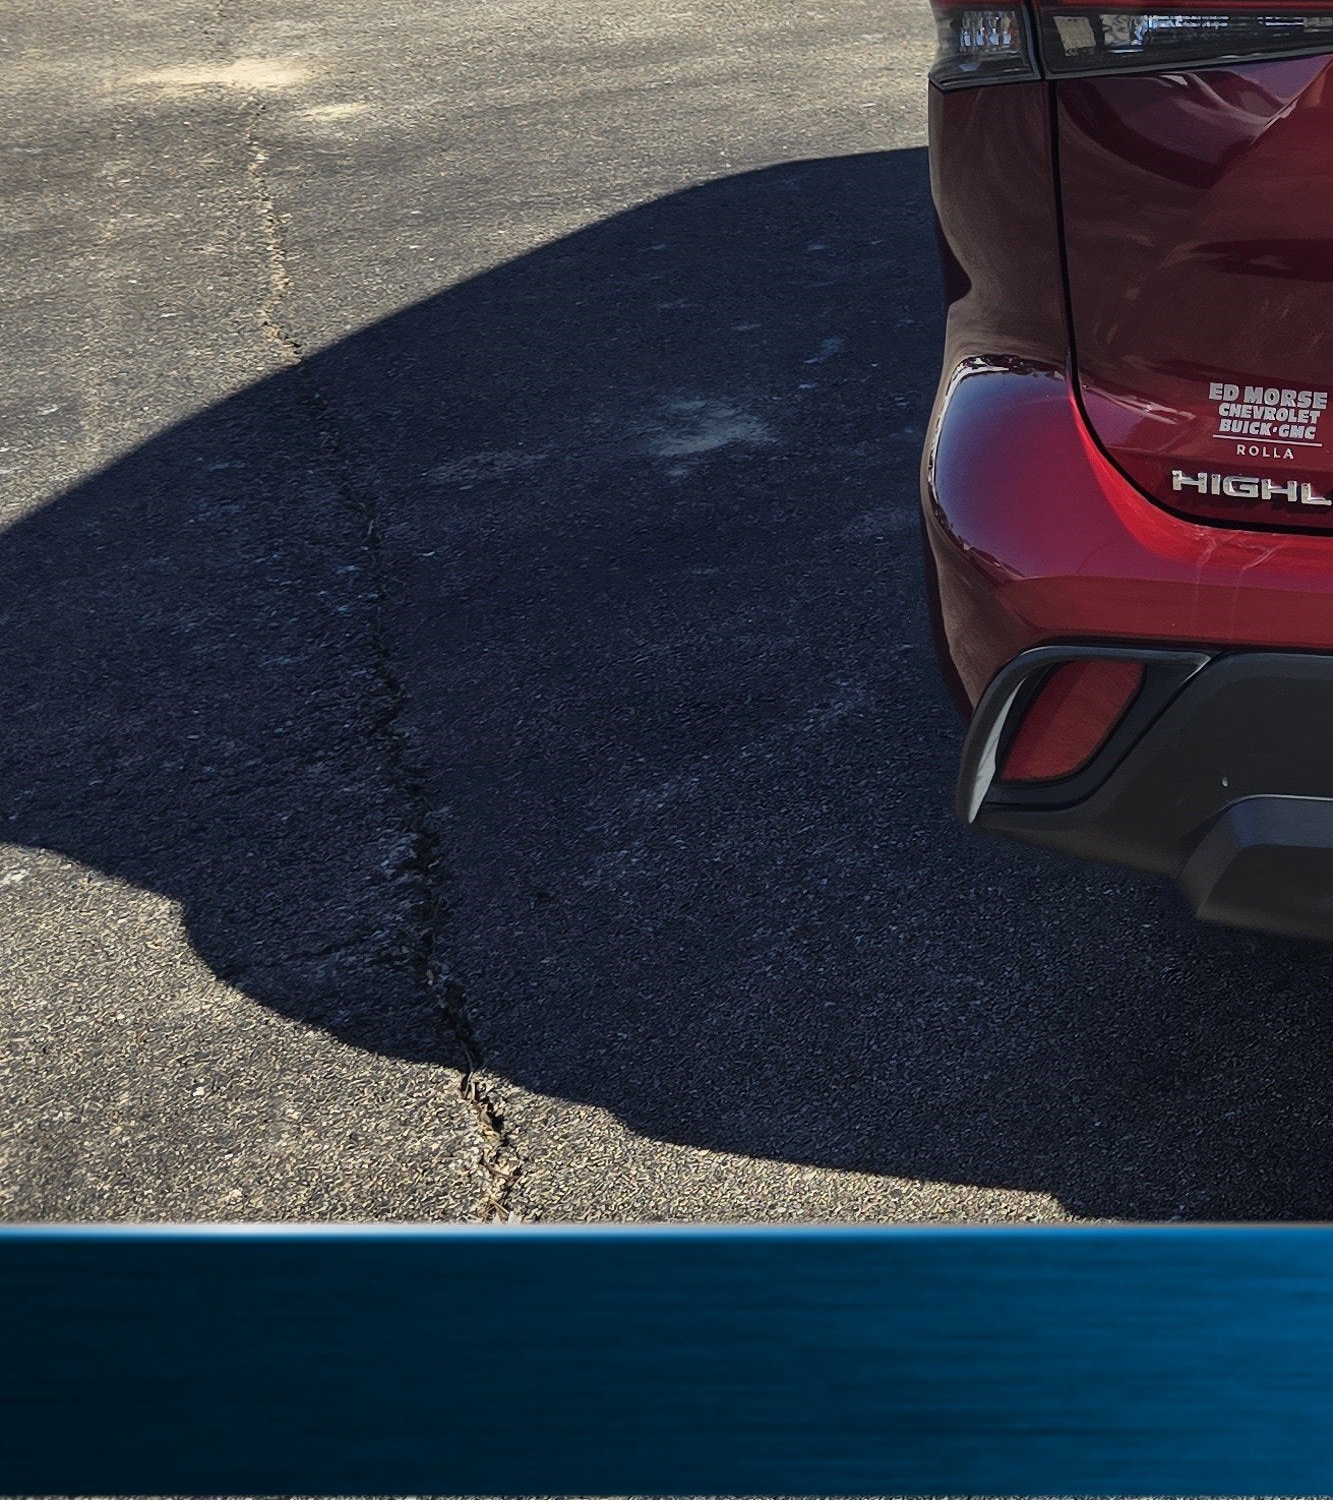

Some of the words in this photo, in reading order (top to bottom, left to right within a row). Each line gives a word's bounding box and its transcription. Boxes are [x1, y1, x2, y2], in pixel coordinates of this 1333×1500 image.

[1208, 382, 1240, 402] ED
[1243, 386, 1328, 410] MORSE
[1218, 402, 1321, 424] CHEVROLET
[1236, 444, 1294, 460] ROLLA
